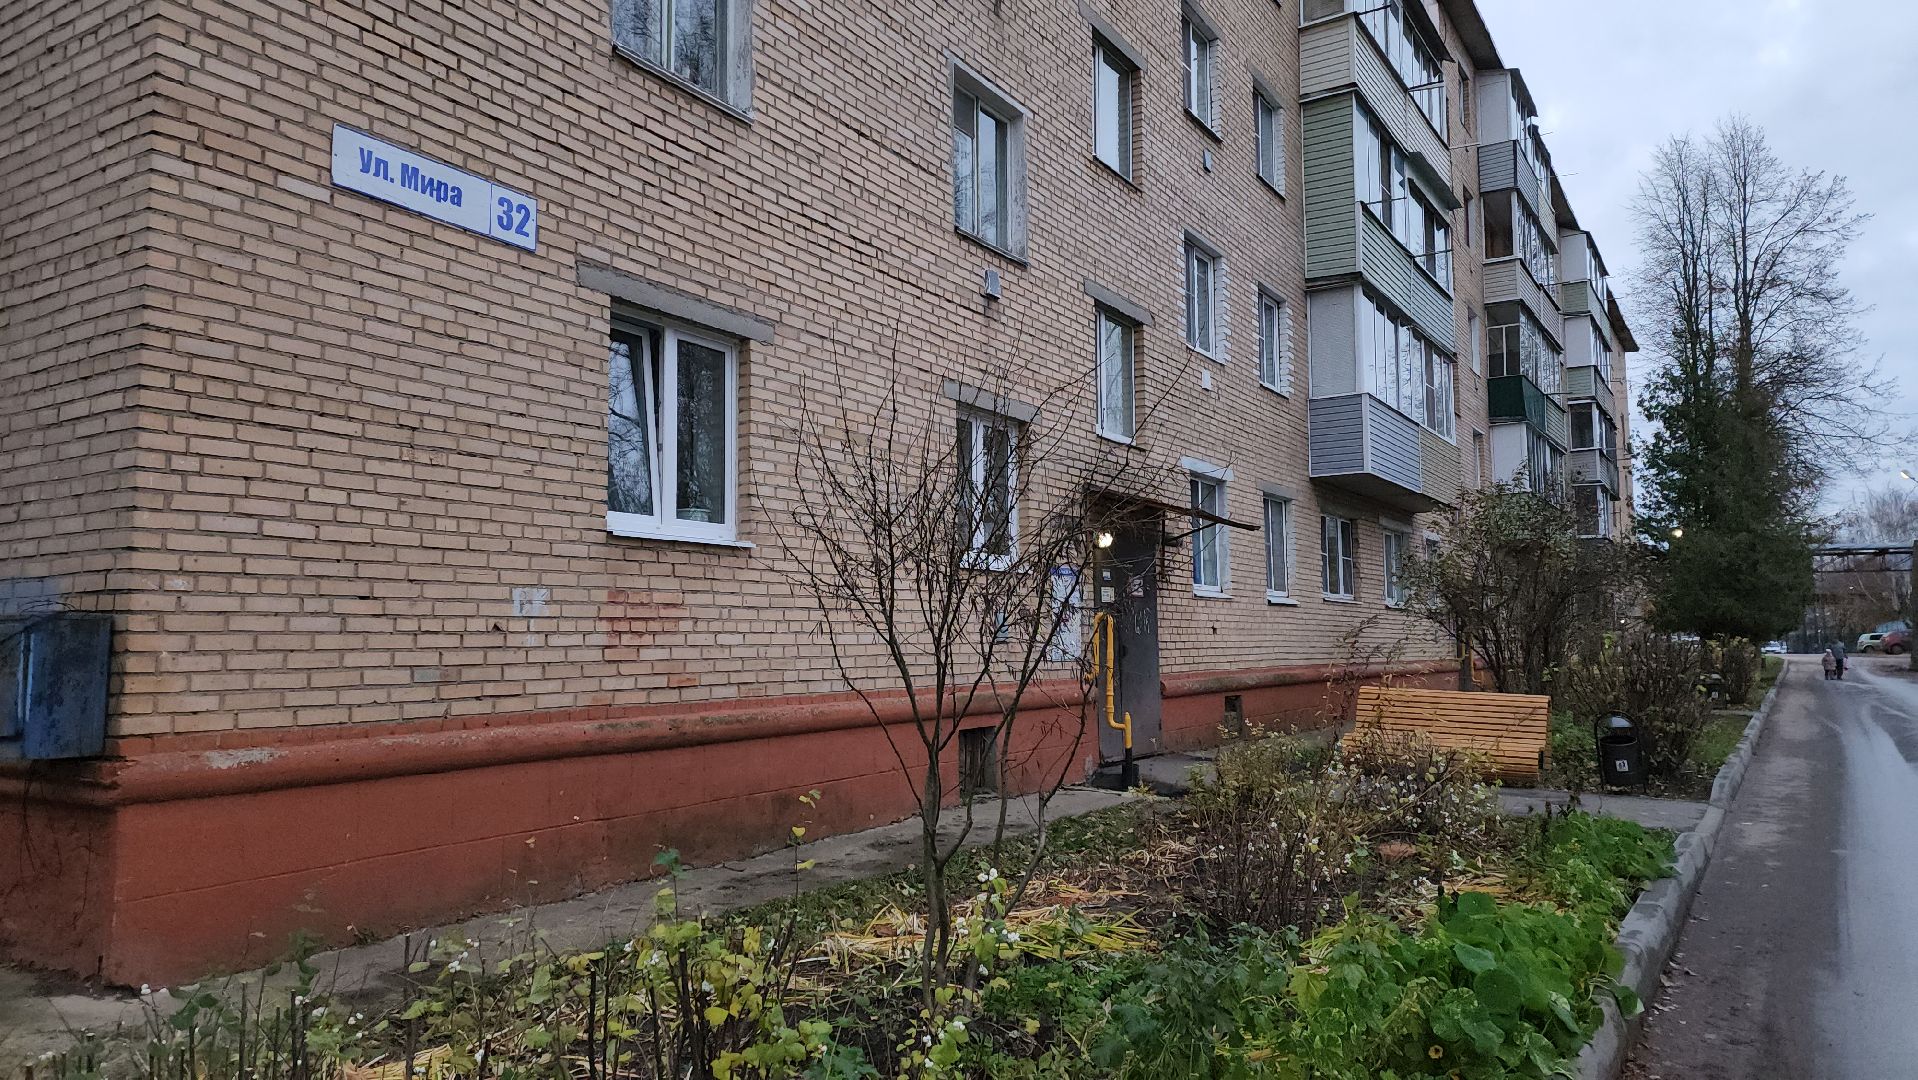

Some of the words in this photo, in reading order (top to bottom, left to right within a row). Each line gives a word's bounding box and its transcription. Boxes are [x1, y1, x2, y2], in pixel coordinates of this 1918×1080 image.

[358, 146, 395, 183] Ул.
[400, 163, 463, 207] Мира
[497, 196, 531, 238] 32
